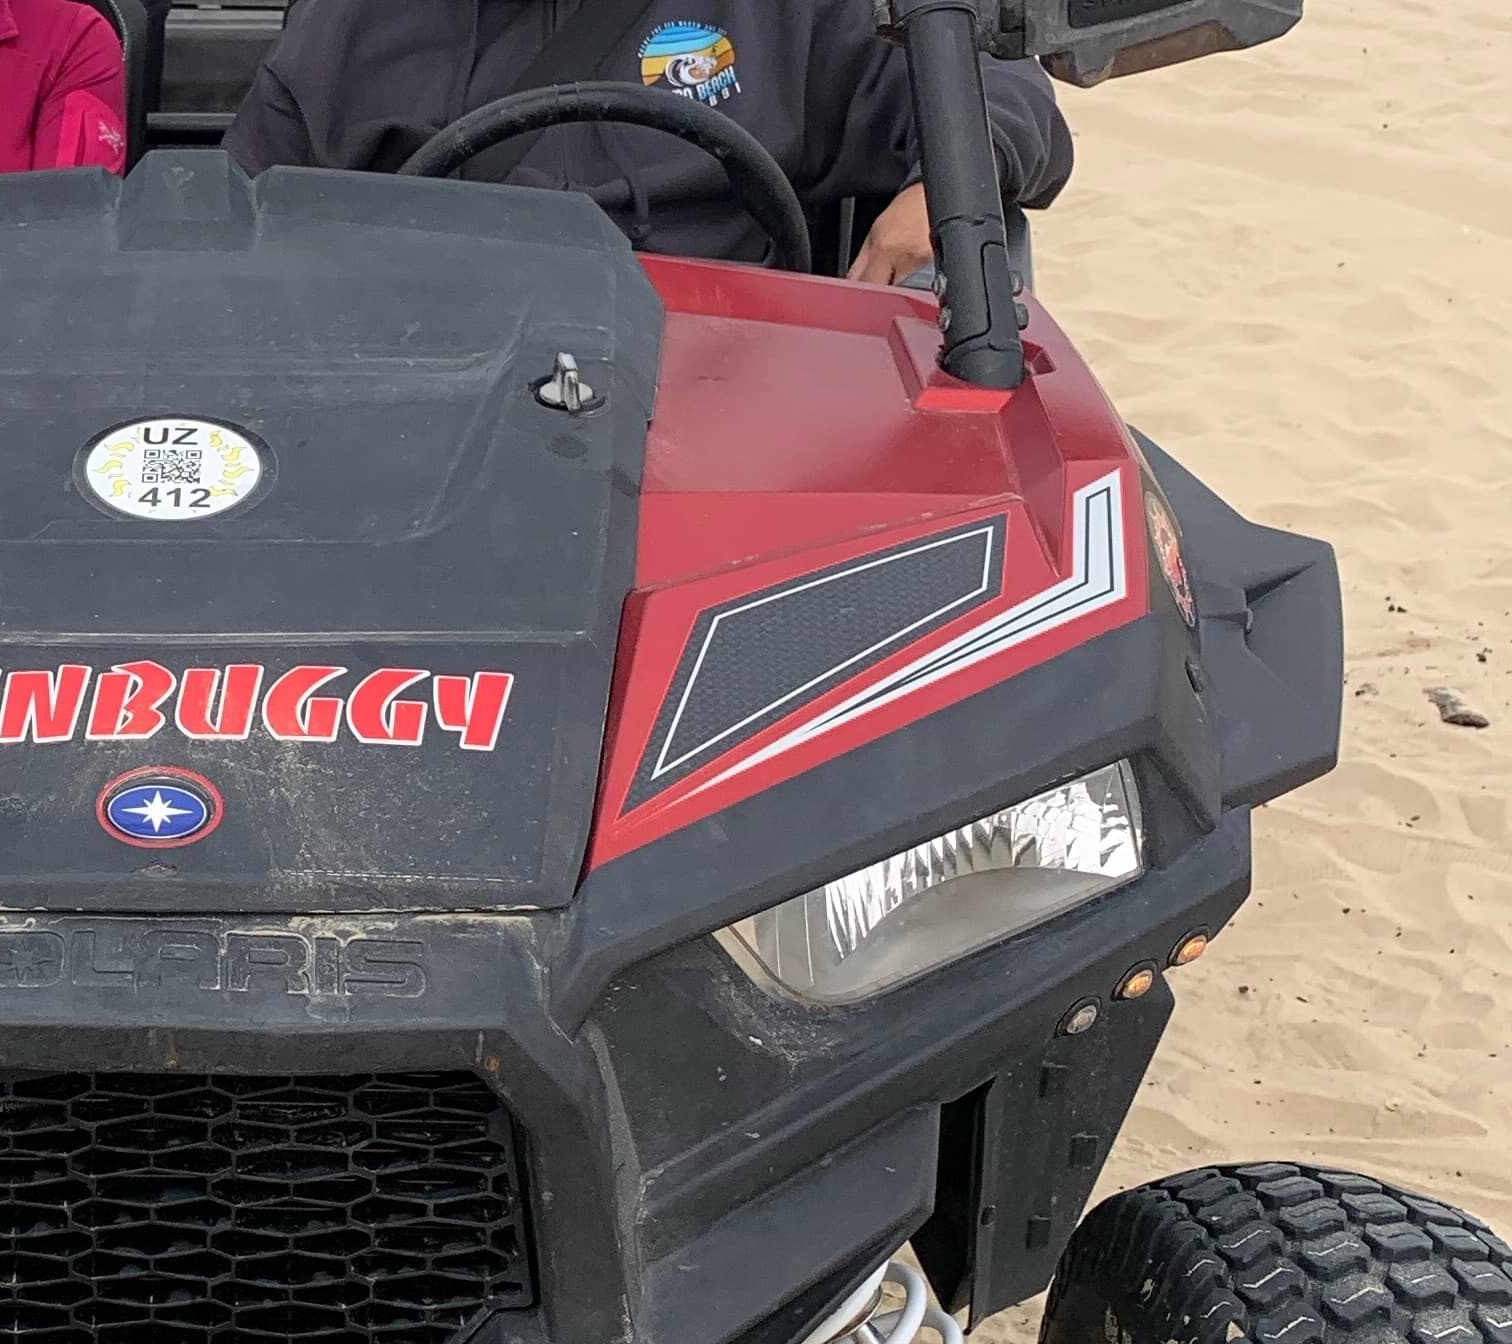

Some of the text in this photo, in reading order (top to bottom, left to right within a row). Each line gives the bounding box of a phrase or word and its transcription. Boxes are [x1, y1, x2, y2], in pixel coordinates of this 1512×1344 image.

[696, 65, 737, 101] BEACH
[142, 427, 199, 445] UZ
[138, 487, 212, 508] 412
